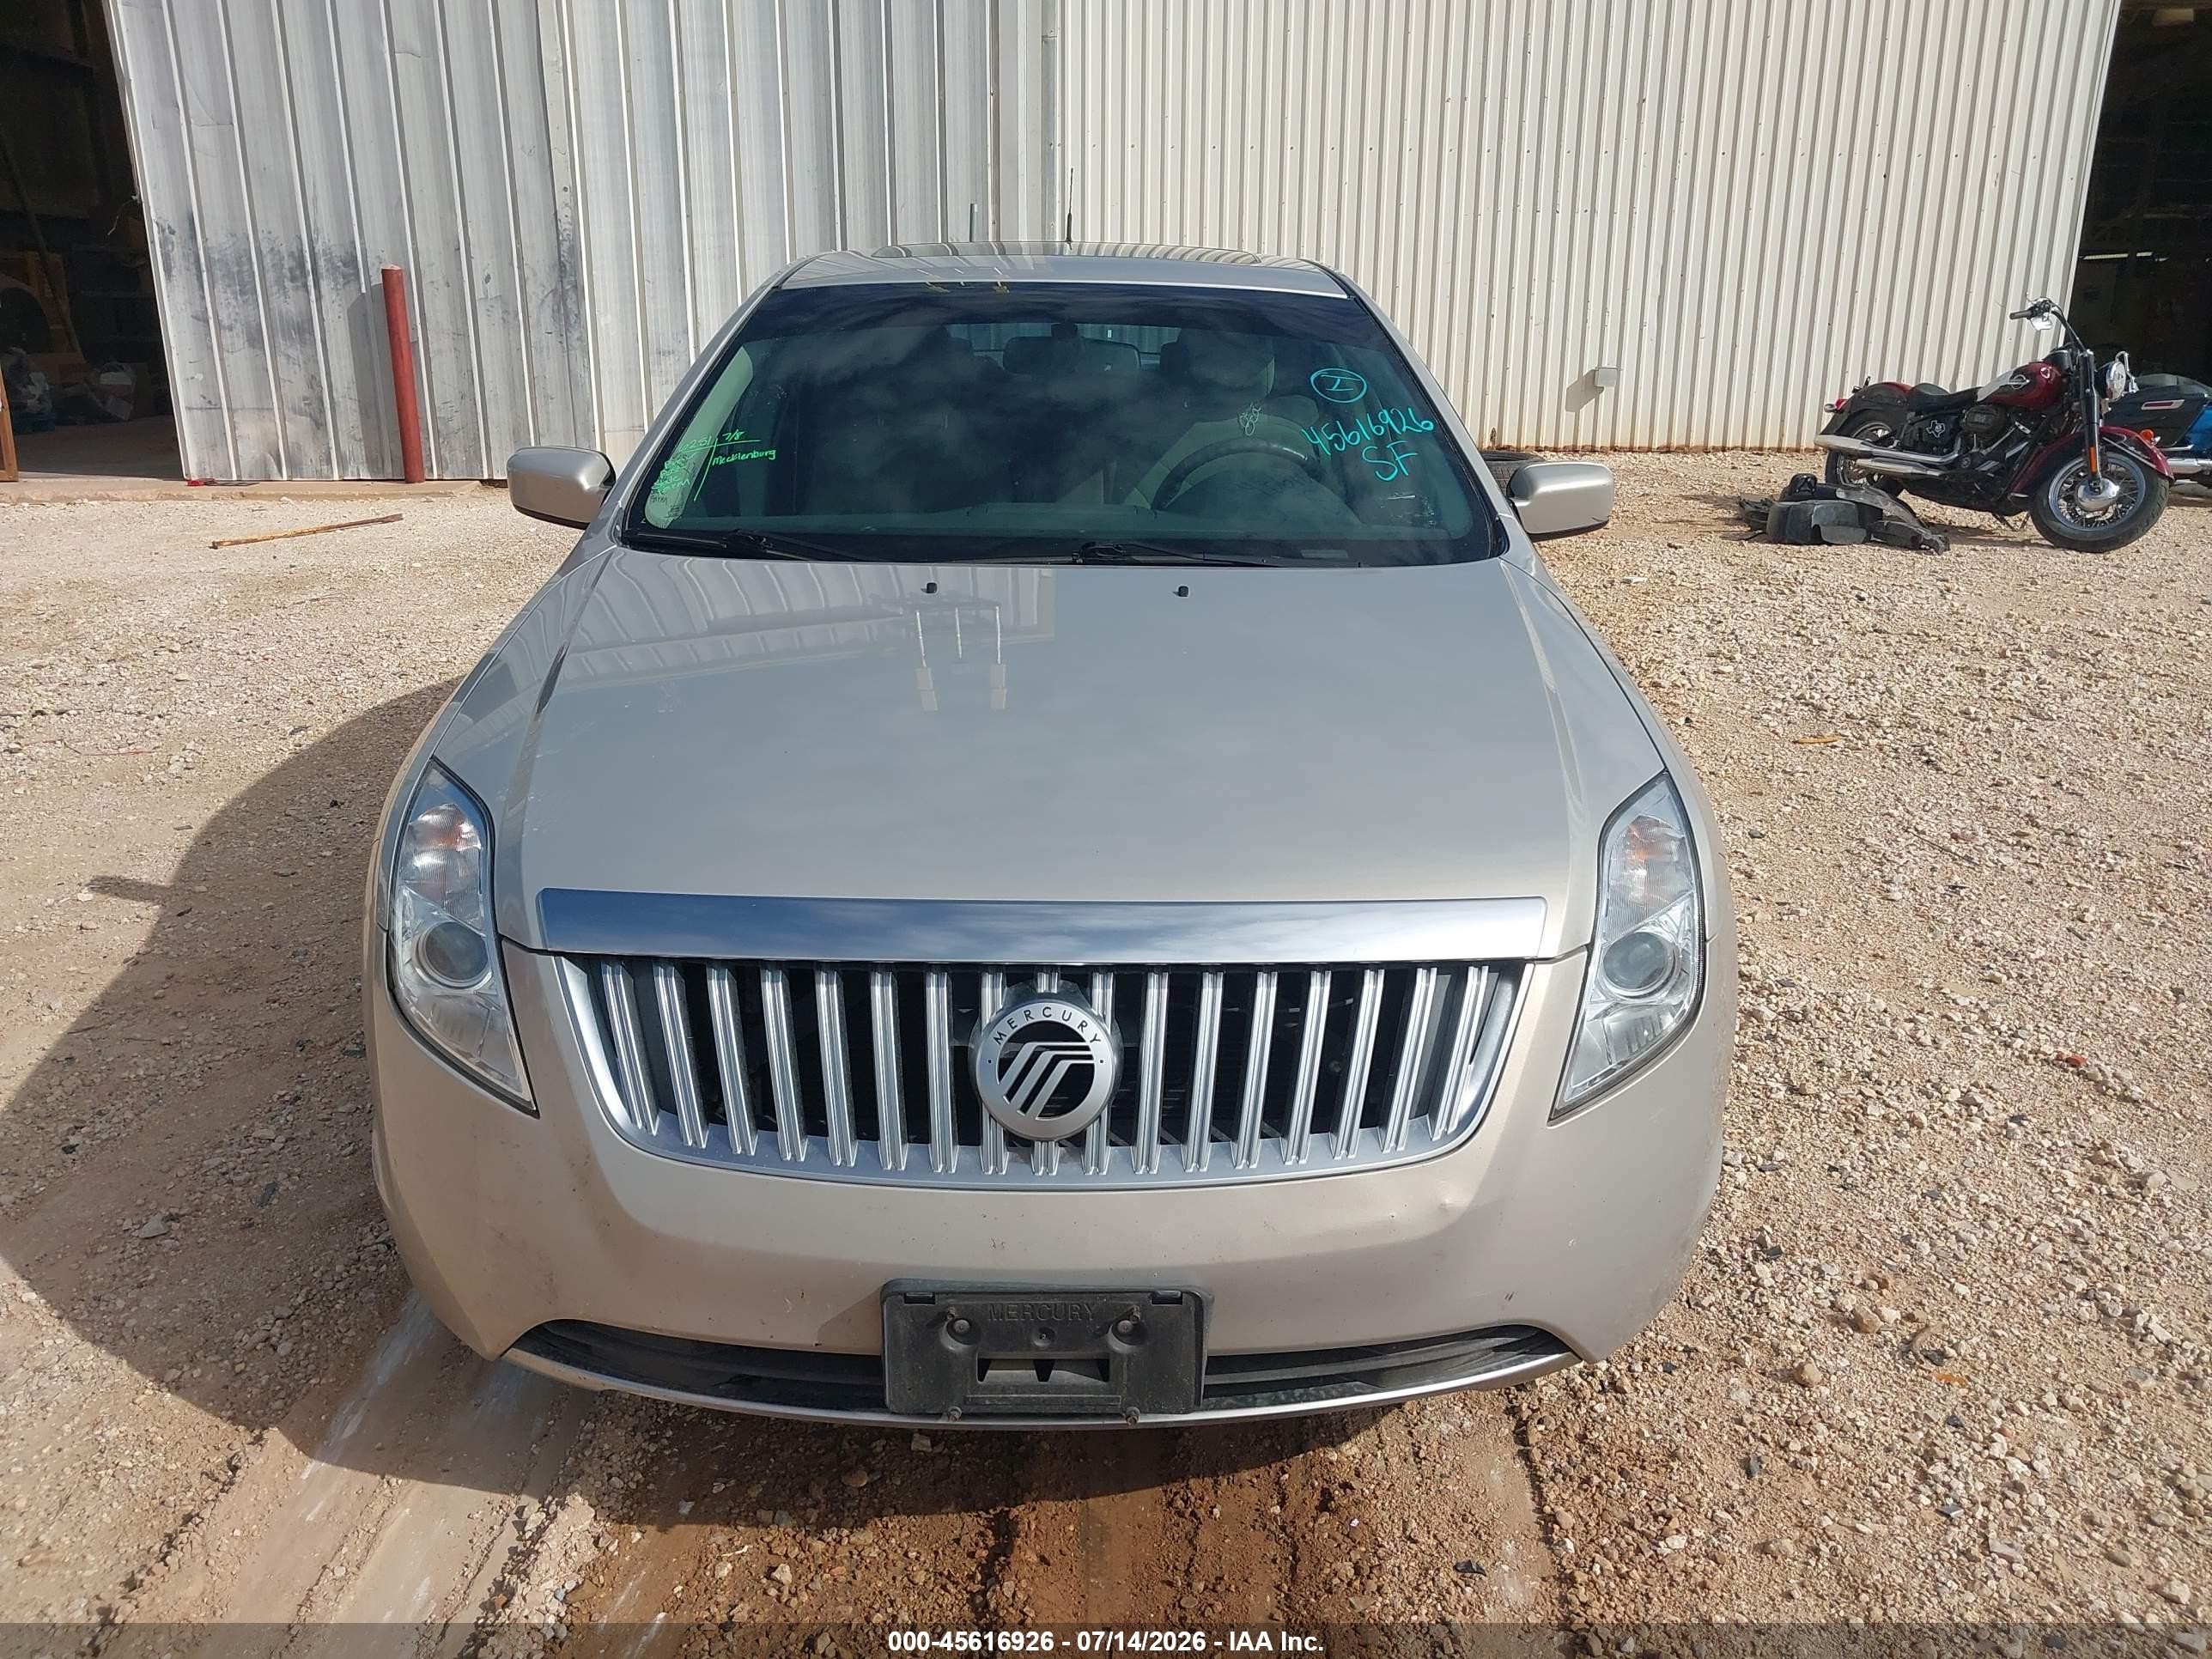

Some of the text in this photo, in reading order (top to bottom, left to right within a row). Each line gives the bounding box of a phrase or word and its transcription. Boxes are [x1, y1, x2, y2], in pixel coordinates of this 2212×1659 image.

[721, 428, 745, 441] 7/8
[1302, 407, 1434, 455] 45616926
[1362, 440, 1419, 481] SF
[993, 1006, 1102, 1046] MERCURY
[988, 1302, 1097, 1322] MERCURY
